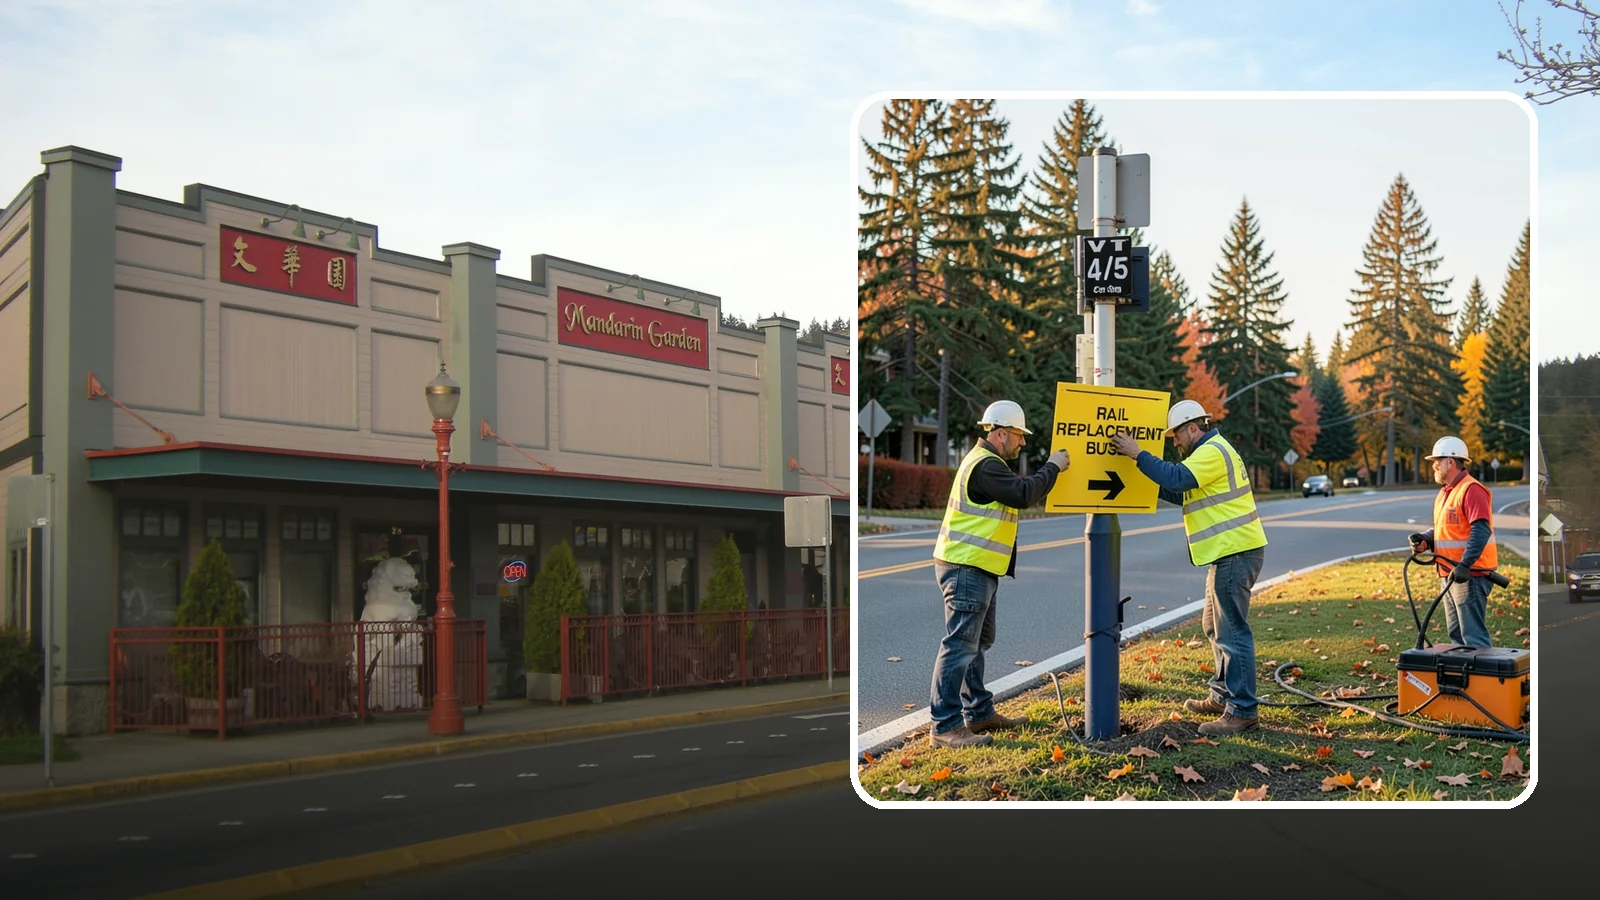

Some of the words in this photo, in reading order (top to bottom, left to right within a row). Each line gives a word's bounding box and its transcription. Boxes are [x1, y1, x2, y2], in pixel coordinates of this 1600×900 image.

[1087, 255, 1128, 281] 4/5
[564, 302, 644, 341] Mandarin
[647, 320, 702, 352] Garden
[1096, 406, 1129, 421] RAIL
[503, 565, 527, 578] OPEN
